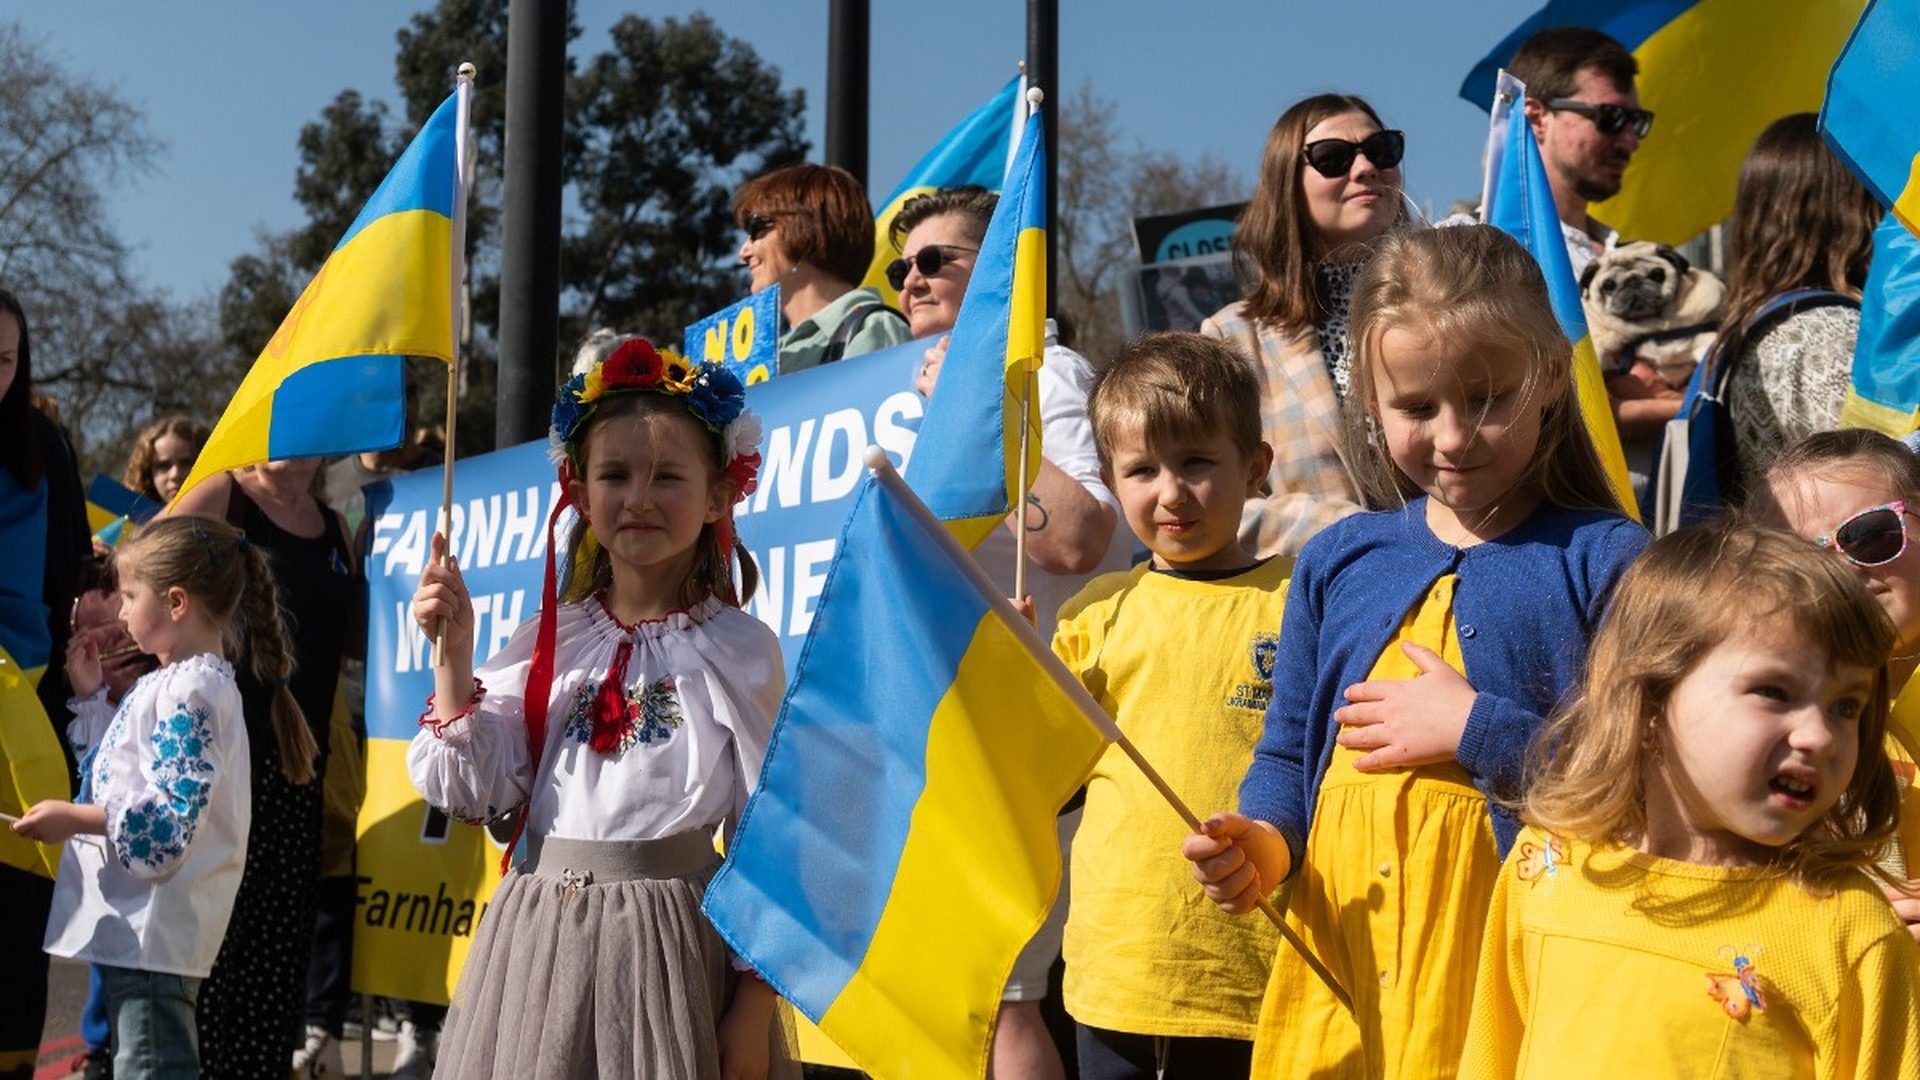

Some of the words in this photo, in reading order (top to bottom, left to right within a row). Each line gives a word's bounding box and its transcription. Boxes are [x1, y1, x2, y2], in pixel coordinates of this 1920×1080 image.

[1167, 236, 1234, 260] CLOS
[704, 306, 754, 363] NO
[370, 483, 576, 577] FARNHA
[733, 392, 923, 515] NDS
[394, 589, 525, 672] WTH
